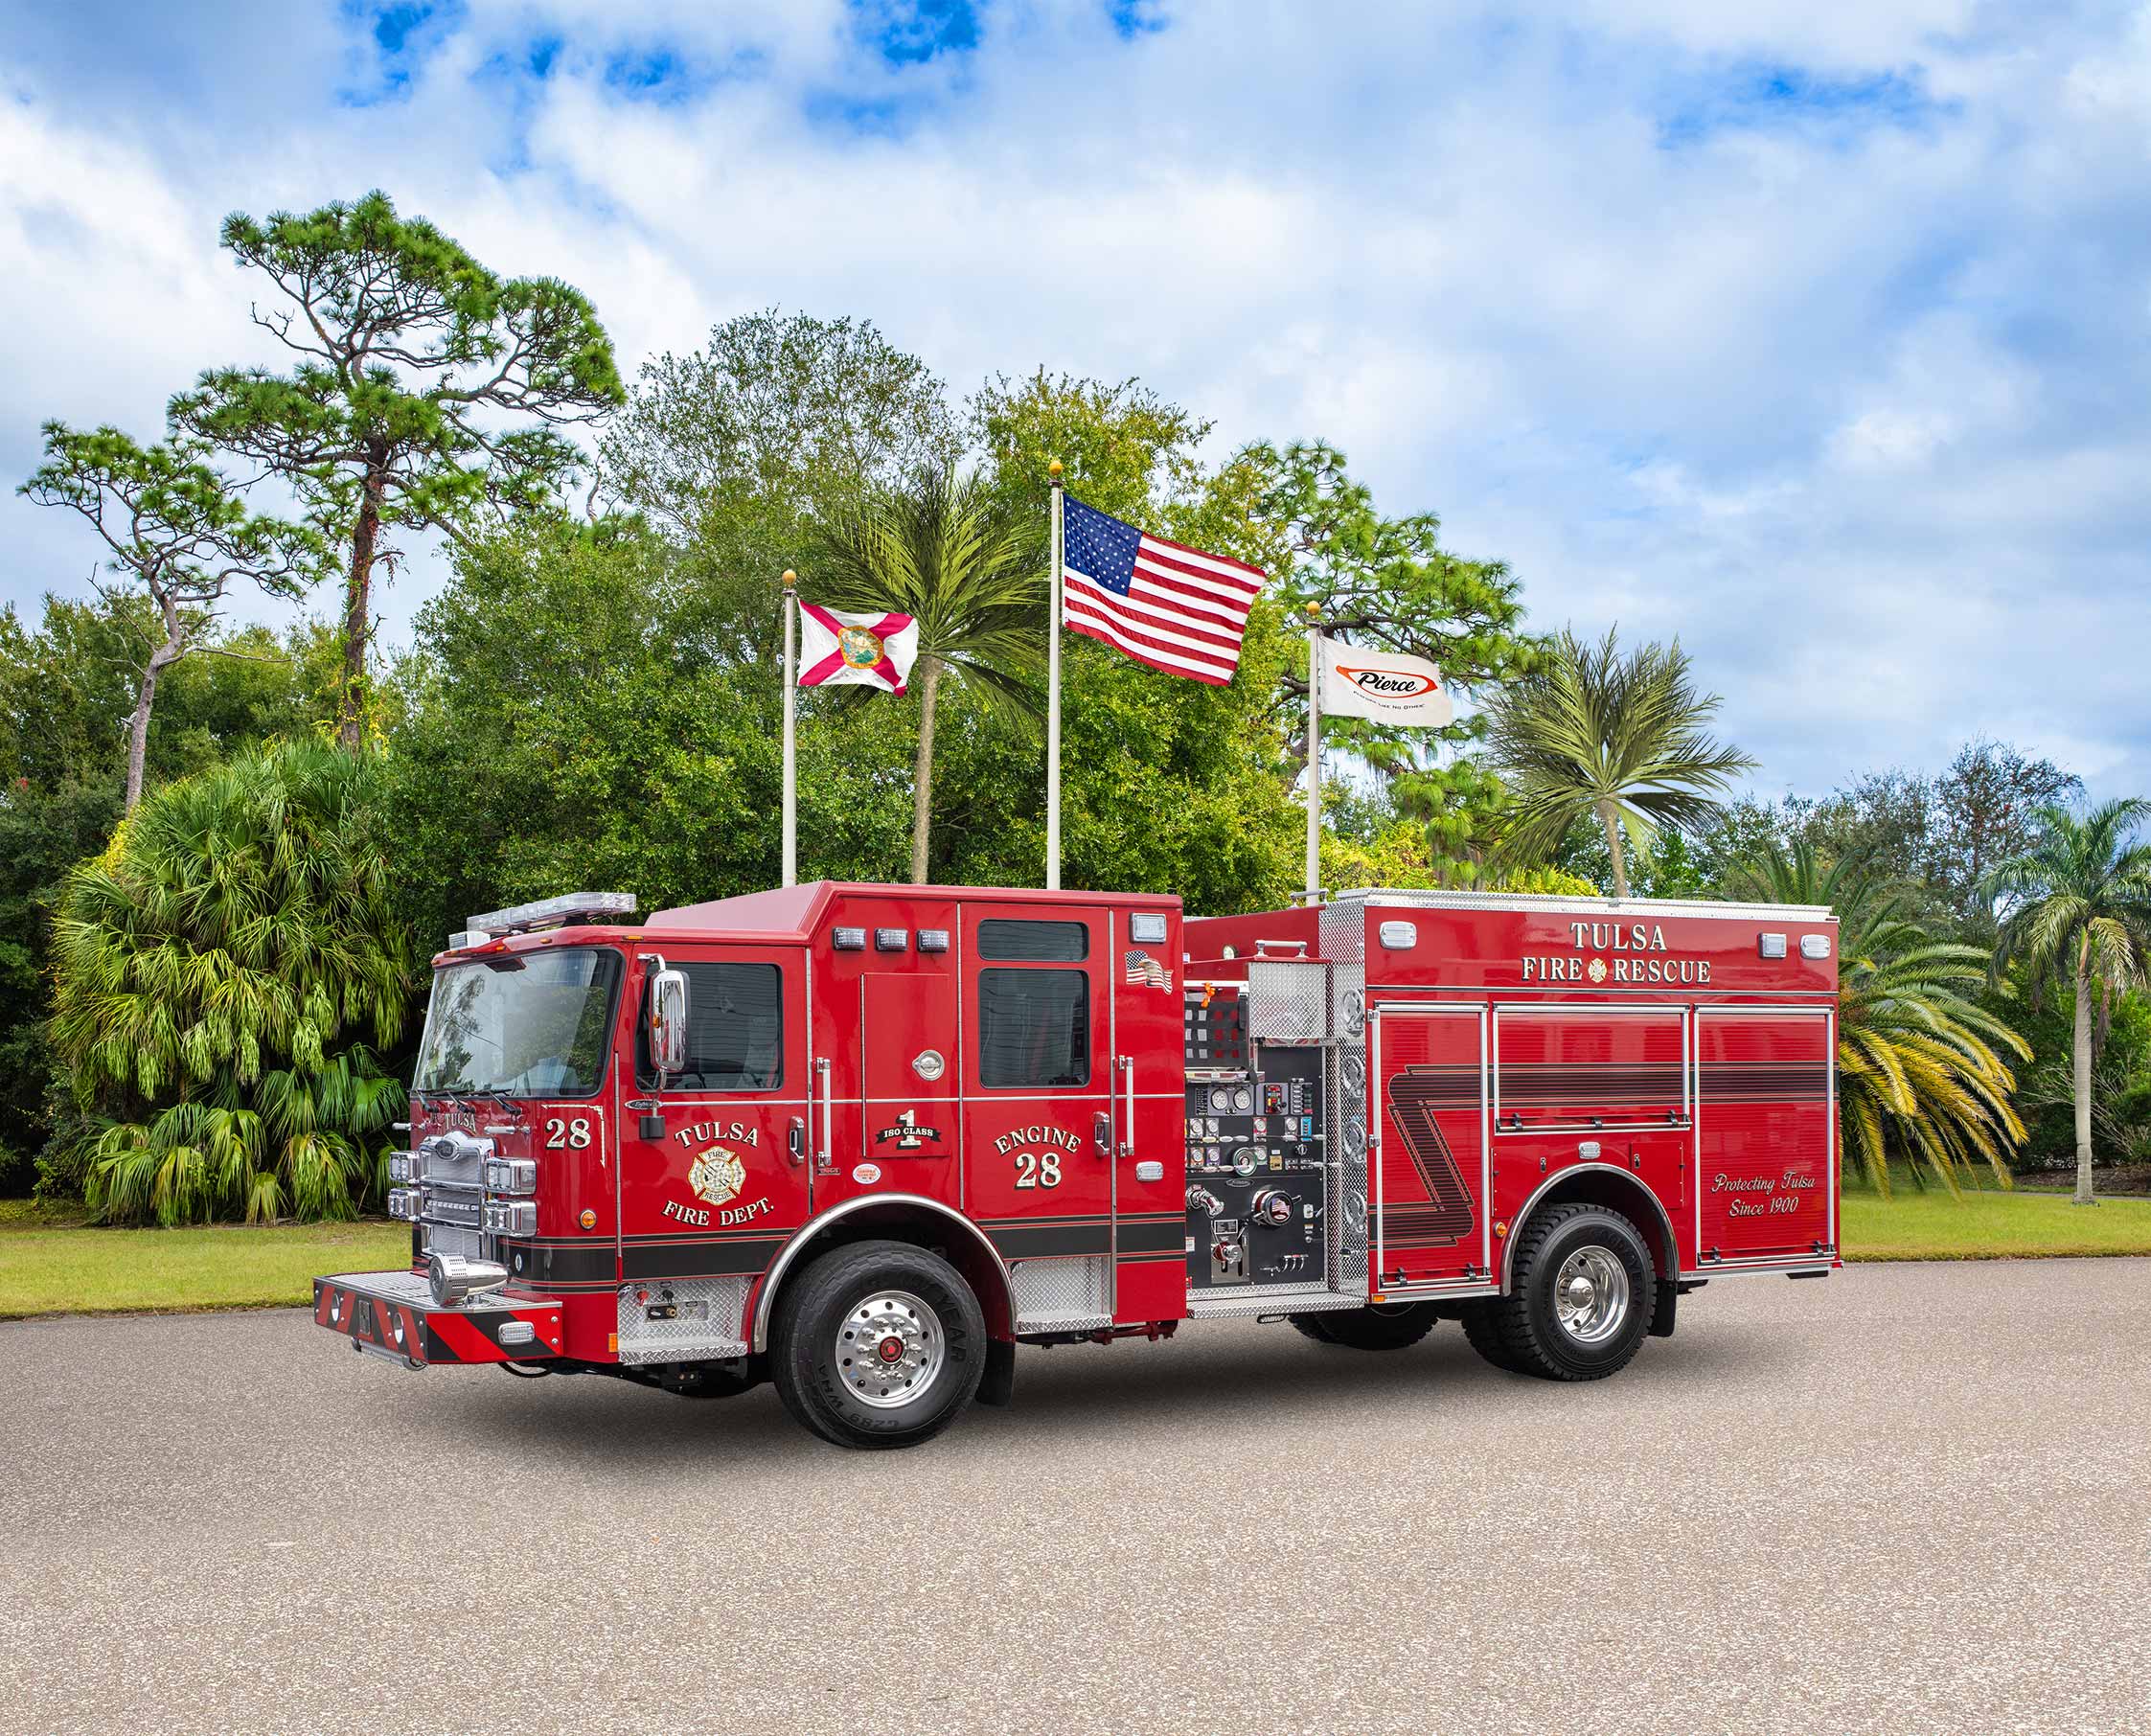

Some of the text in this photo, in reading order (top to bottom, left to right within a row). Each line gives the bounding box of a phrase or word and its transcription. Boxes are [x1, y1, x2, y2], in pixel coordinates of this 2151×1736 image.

[1358, 672, 1416, 692] Pierce
[1570, 922, 1667, 951] TULSA
[1522, 956, 1710, 983] FIRE RESCUE
[545, 1118, 591, 1150] 28
[675, 1121, 758, 1148] TULSA
[884, 1128, 934, 1138] ISO CLASS
[896, 1109, 922, 1150] 1
[994, 1126, 1082, 1155] ENGINE
[707, 1151, 725, 1159] FIRE
[1014, 1152, 1062, 1190] 28
[1711, 1171, 1816, 1196] Protecting Tulsa
[704, 1192, 731, 1200] RESCUE
[1728, 1196, 1799, 1217] Since 1900
[661, 1197, 774, 1226] FIRE DEPT.
